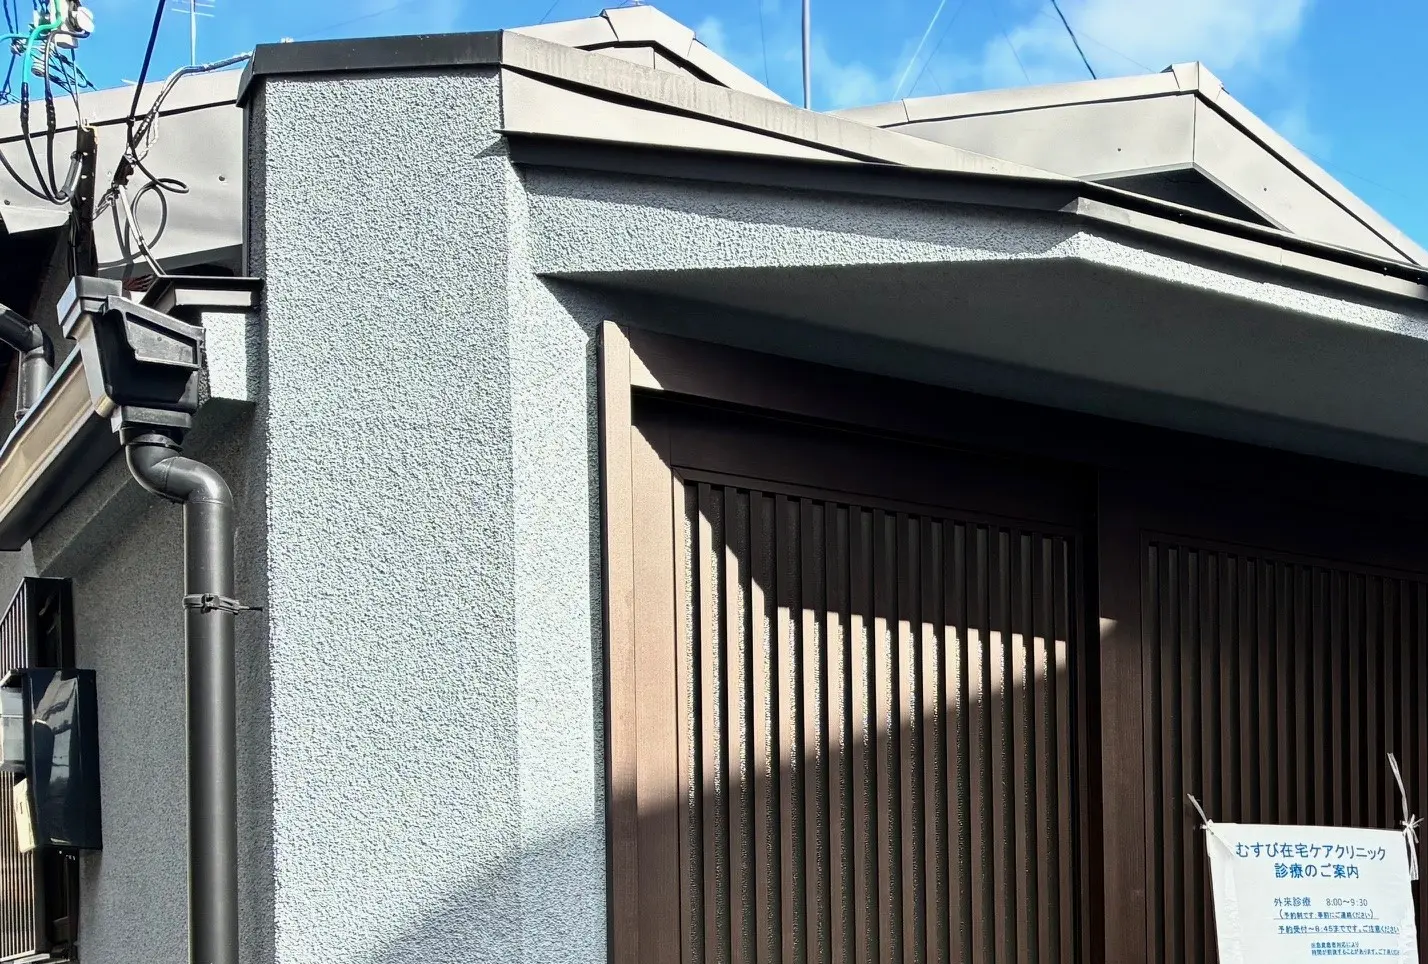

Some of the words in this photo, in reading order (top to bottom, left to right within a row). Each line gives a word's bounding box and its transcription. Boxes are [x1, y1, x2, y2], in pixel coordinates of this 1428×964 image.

[1235, 842, 1386, 861] むすび在宅ケアクリニック
[1274, 863, 1359, 879] 診療のご案内
[1273, 897, 1312, 907] 外来診療
